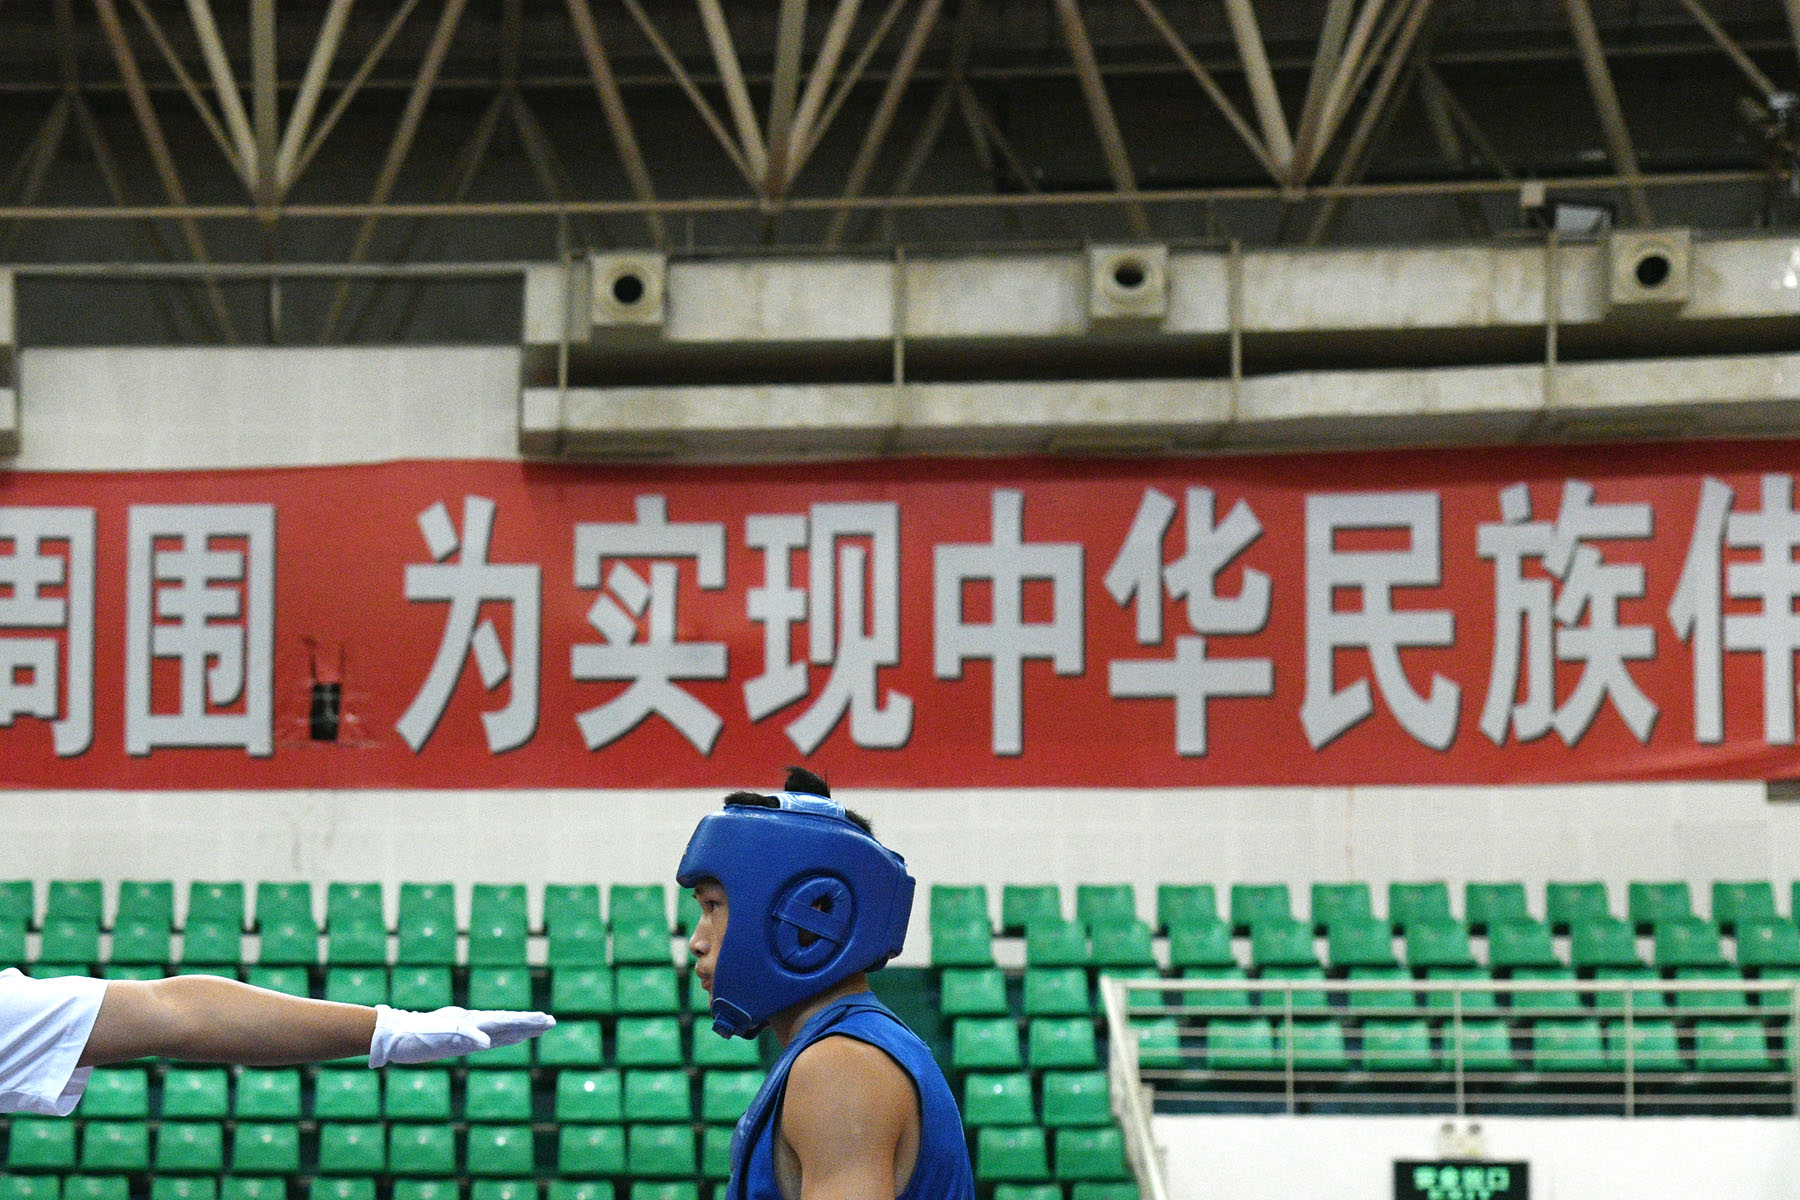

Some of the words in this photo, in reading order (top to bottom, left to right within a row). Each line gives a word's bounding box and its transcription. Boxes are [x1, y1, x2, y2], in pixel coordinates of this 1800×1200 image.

[395, 473, 1800, 757] 为实现中华民族伟
